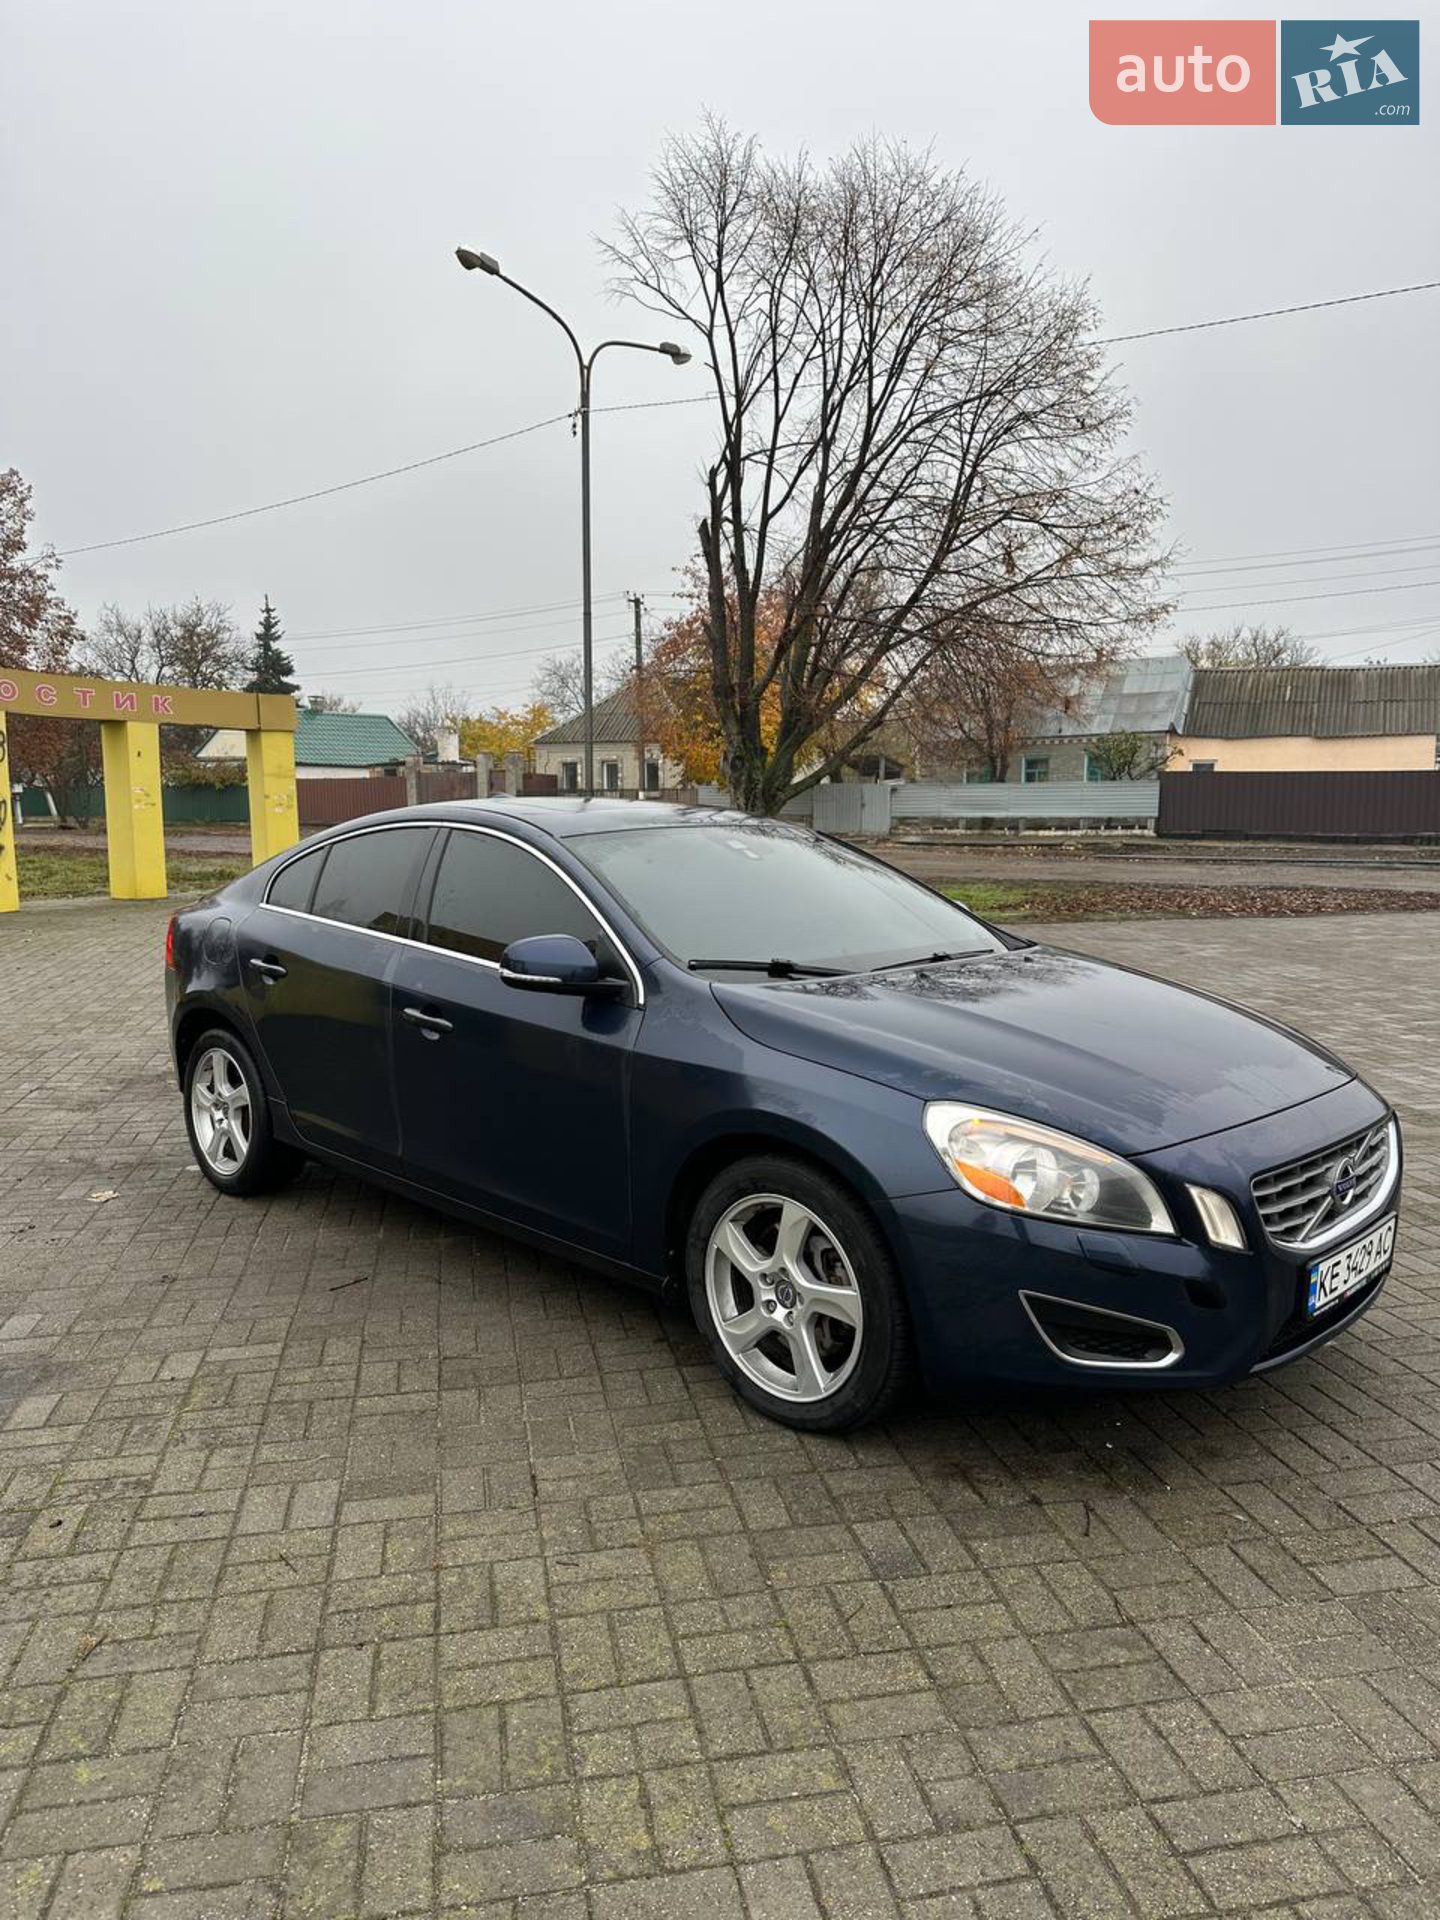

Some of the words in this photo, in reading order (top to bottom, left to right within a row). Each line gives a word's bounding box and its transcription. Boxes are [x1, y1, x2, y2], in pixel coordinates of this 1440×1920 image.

[1318, 1260, 1341, 1302] KE
[1343, 1239, 1374, 1285] 3429
[1374, 1225, 1393, 1262] AC
